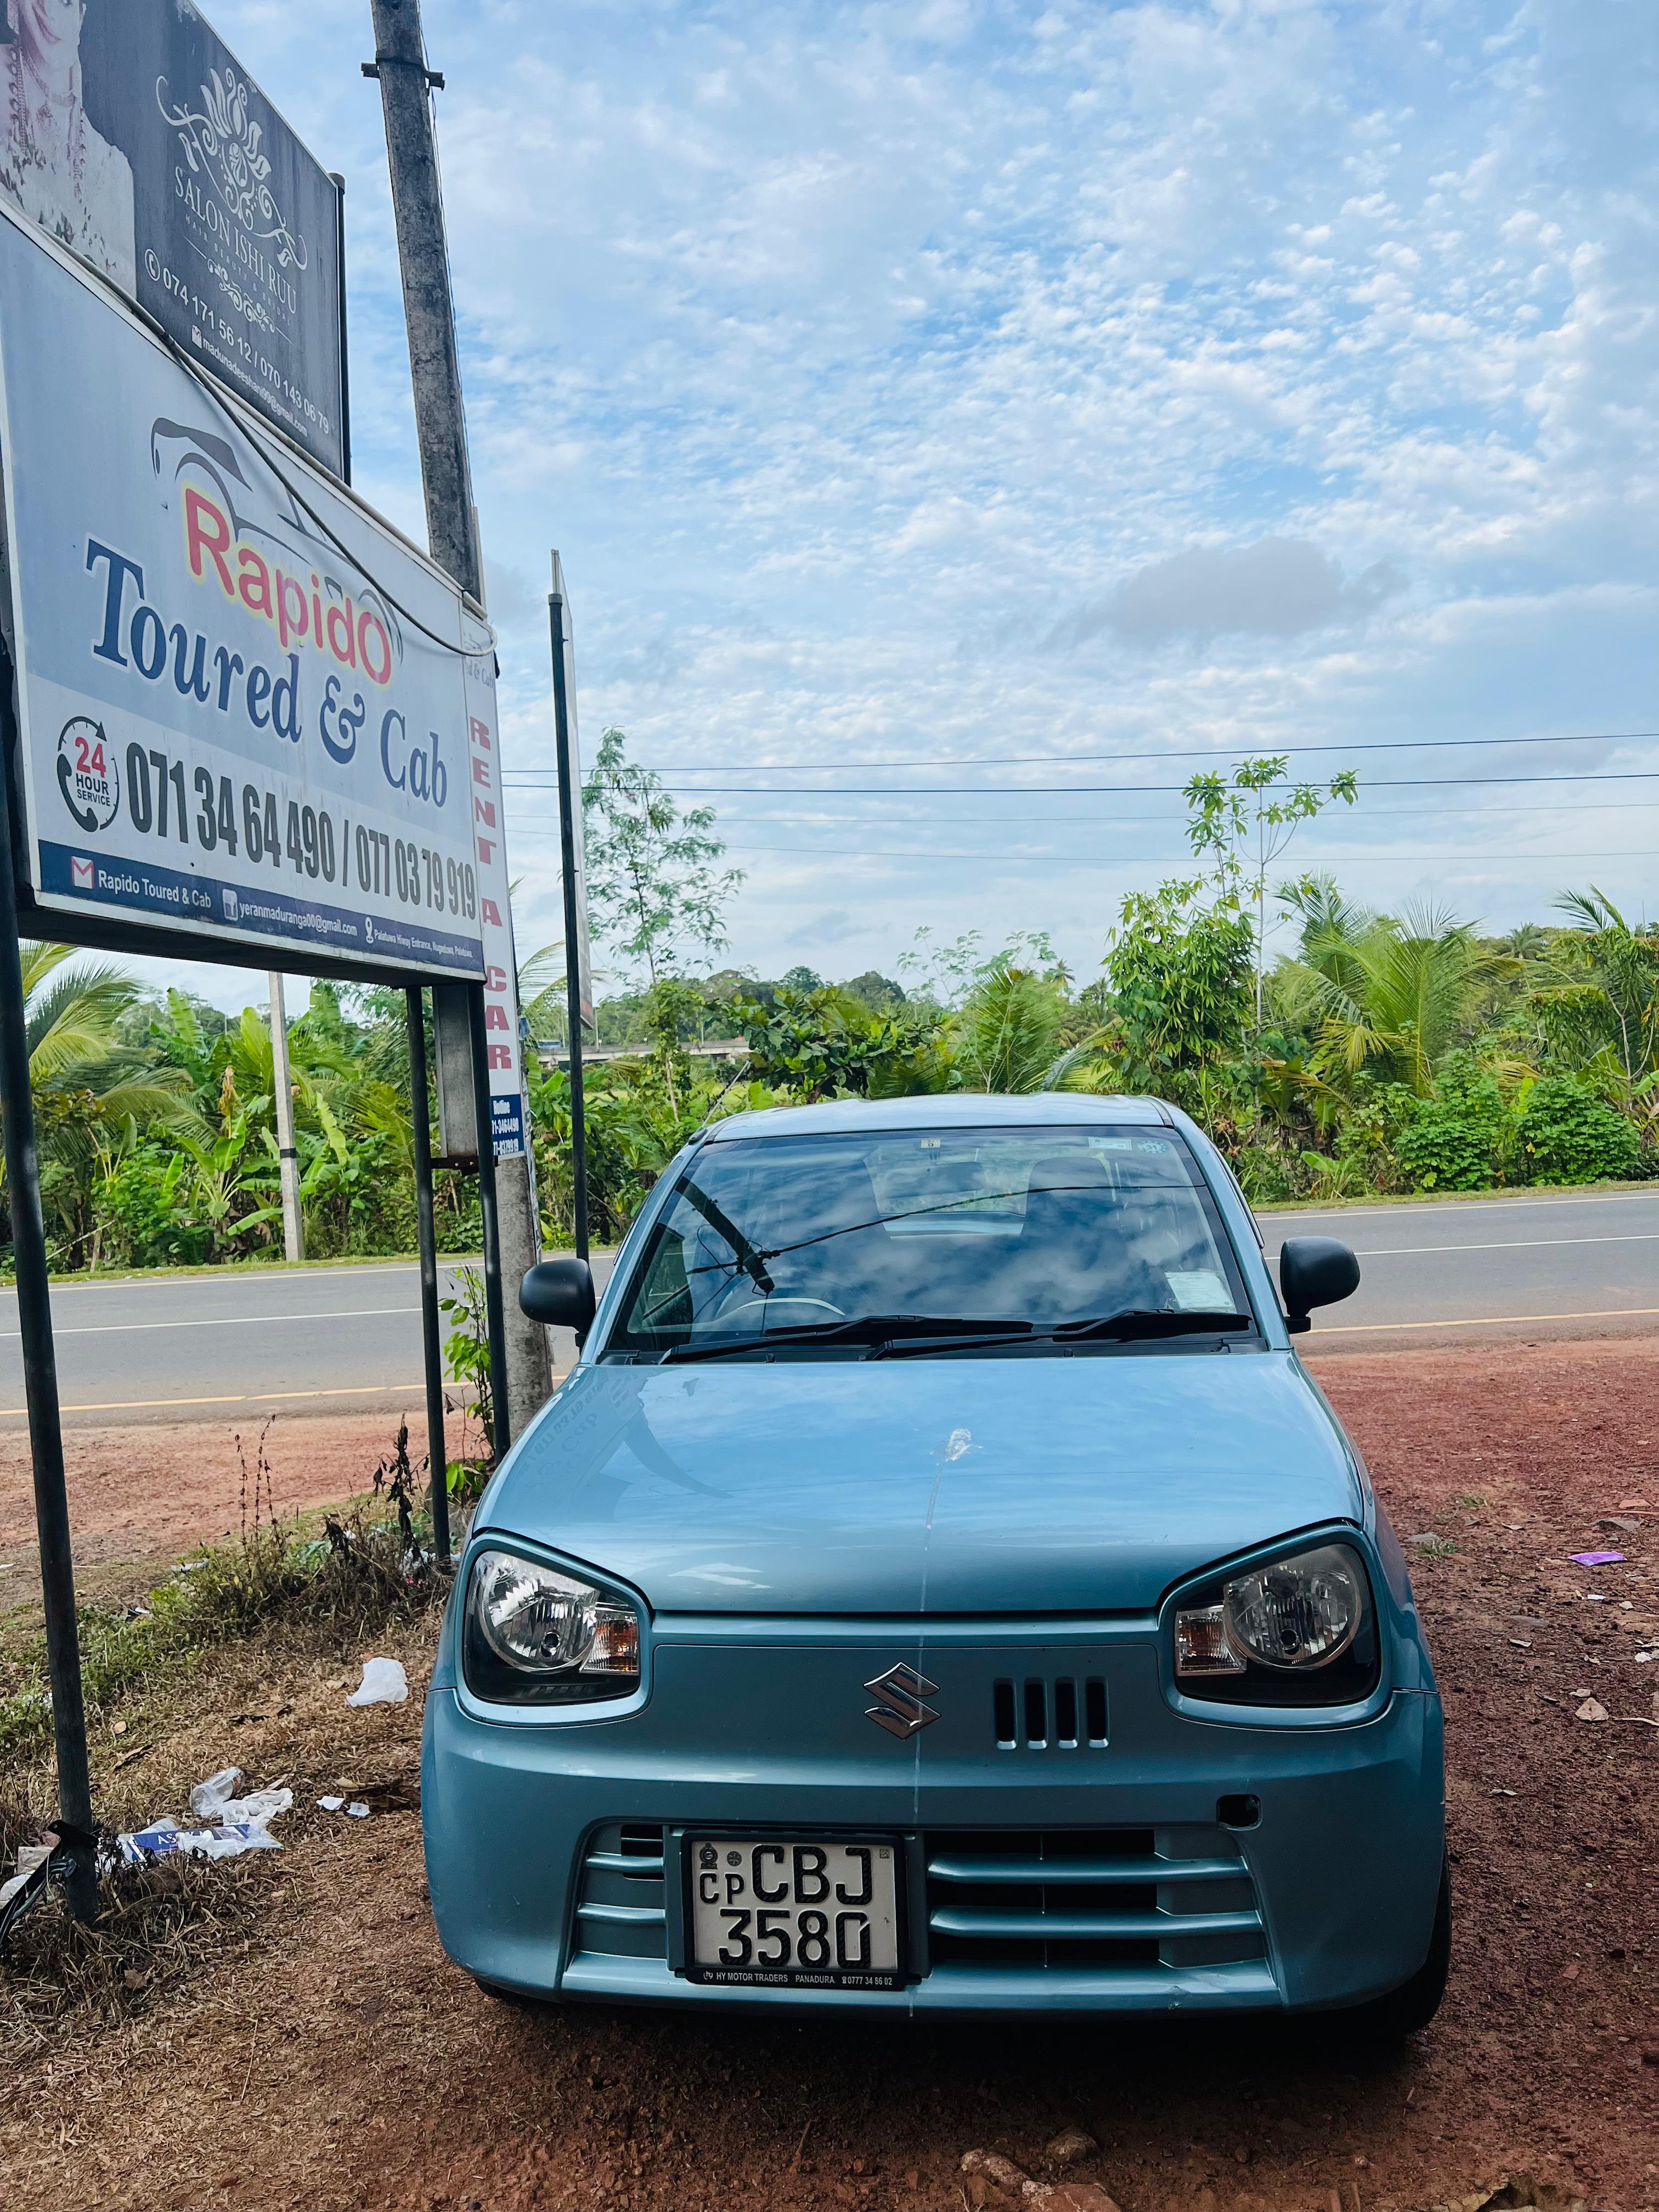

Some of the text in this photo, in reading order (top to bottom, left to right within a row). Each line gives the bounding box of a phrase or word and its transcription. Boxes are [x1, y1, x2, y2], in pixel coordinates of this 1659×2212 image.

[175, 166, 297, 314] SALON ISHI RUU
[185, 213, 208, 242] HAIR
[214, 242, 247, 282] BEAUTY
[163, 267, 189, 306] 074
[192, 296, 215, 330] 171
[219, 318, 235, 347] 56
[237, 336, 252, 364] 12
[260, 357, 281, 389] 070
[283, 379, 302, 409] 143
[303, 398, 316, 422] 06
[318, 410, 330, 435] 79
[86, 538, 448, 808] Toured & Cab
[75, 736, 106, 778] 24
[76, 772, 109, 795] HOUR
[77, 789, 111, 807] SERVICE
[126, 742, 476, 920] 071 34 64 490 / 077 03 79 919
[98, 869, 211, 909] Rapido Toured & Cab
[470, 715, 512, 1069] RENT A CAR
[239, 902, 358, 937] yeranmaduranga00@gmail.com
[491, 1117, 519, 1135] 71-3464490
[493, 1099, 510, 1115] Hotline
[493, 1138, 519, 1156] 77-0379919
[699, 1844, 873, 1906] CP CBJ
[718, 1908, 871, 1970] 3580
[716, 1972, 726, 1980] HY
[727, 1972, 753, 1981] MOTOR
[754, 1973, 788, 1982] TRADERS
[848, 1976, 864, 1985] 0777
[865, 1977, 873, 1985] 34
[884, 1977, 893, 1985] 02
